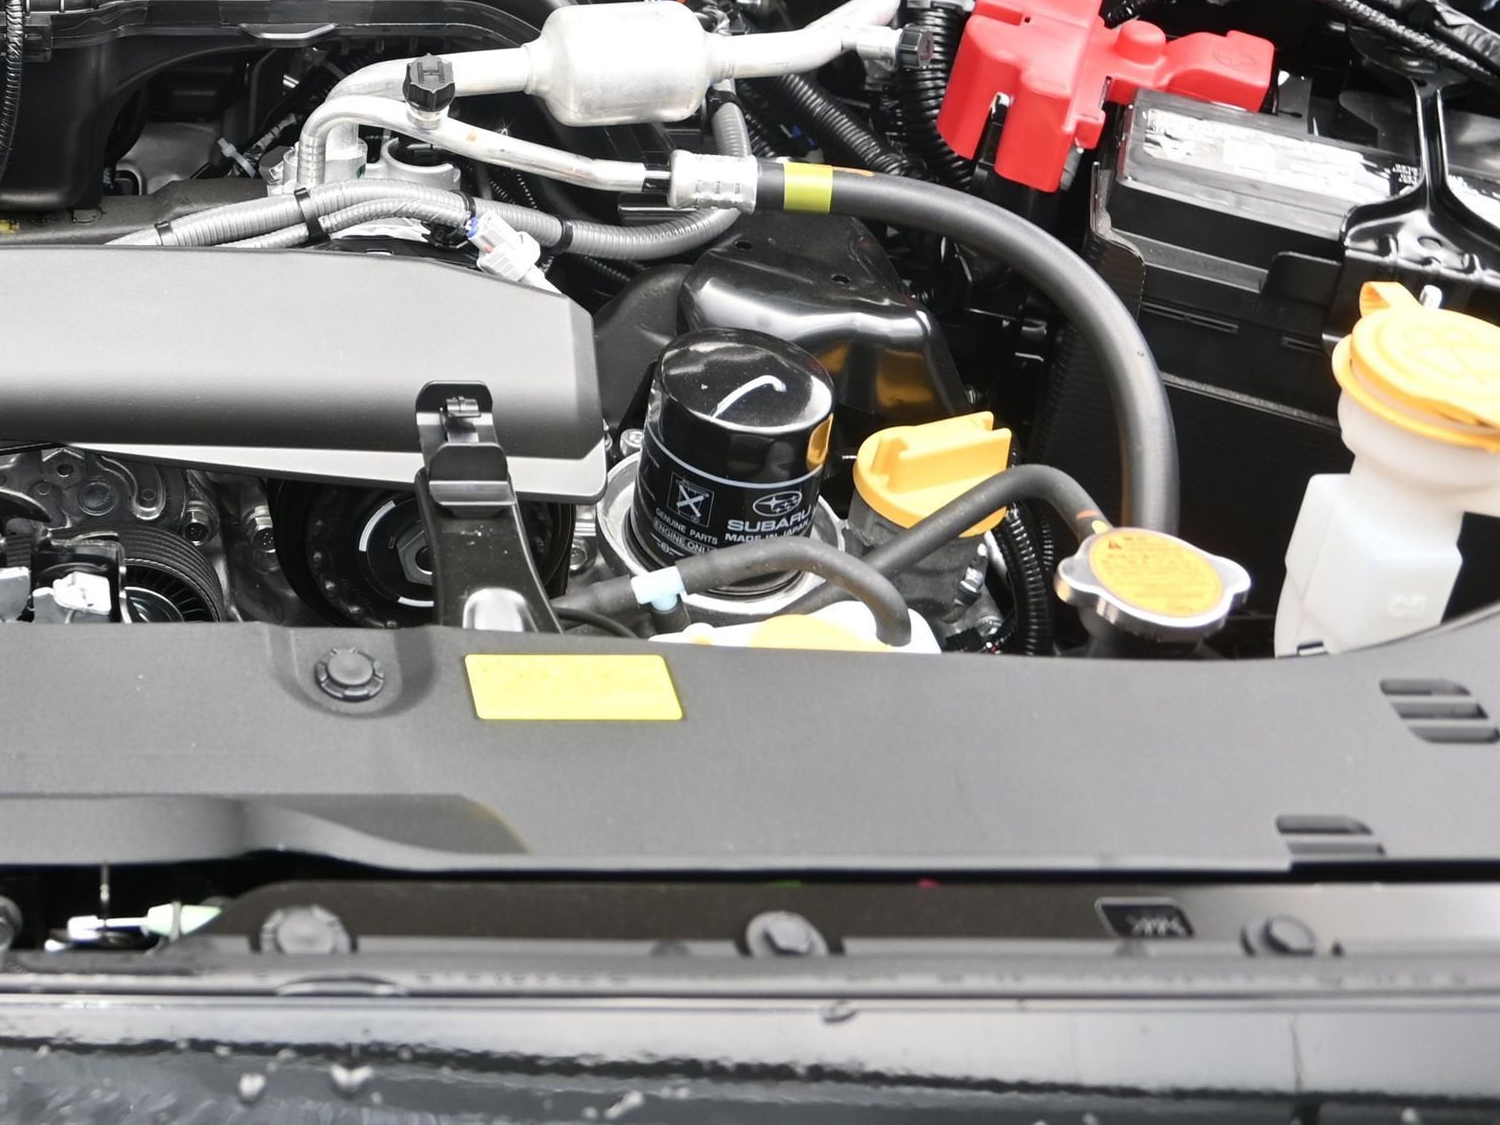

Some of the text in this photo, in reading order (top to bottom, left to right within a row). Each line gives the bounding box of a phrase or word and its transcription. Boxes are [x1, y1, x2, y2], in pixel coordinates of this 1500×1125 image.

[416, 60, 446, 85] H
[654, 518, 687, 547] ENGINE
[655, 507, 719, 545] GENUINE PARTS
[727, 505, 812, 533] SUBARU
[724, 532, 762, 543] MADE
